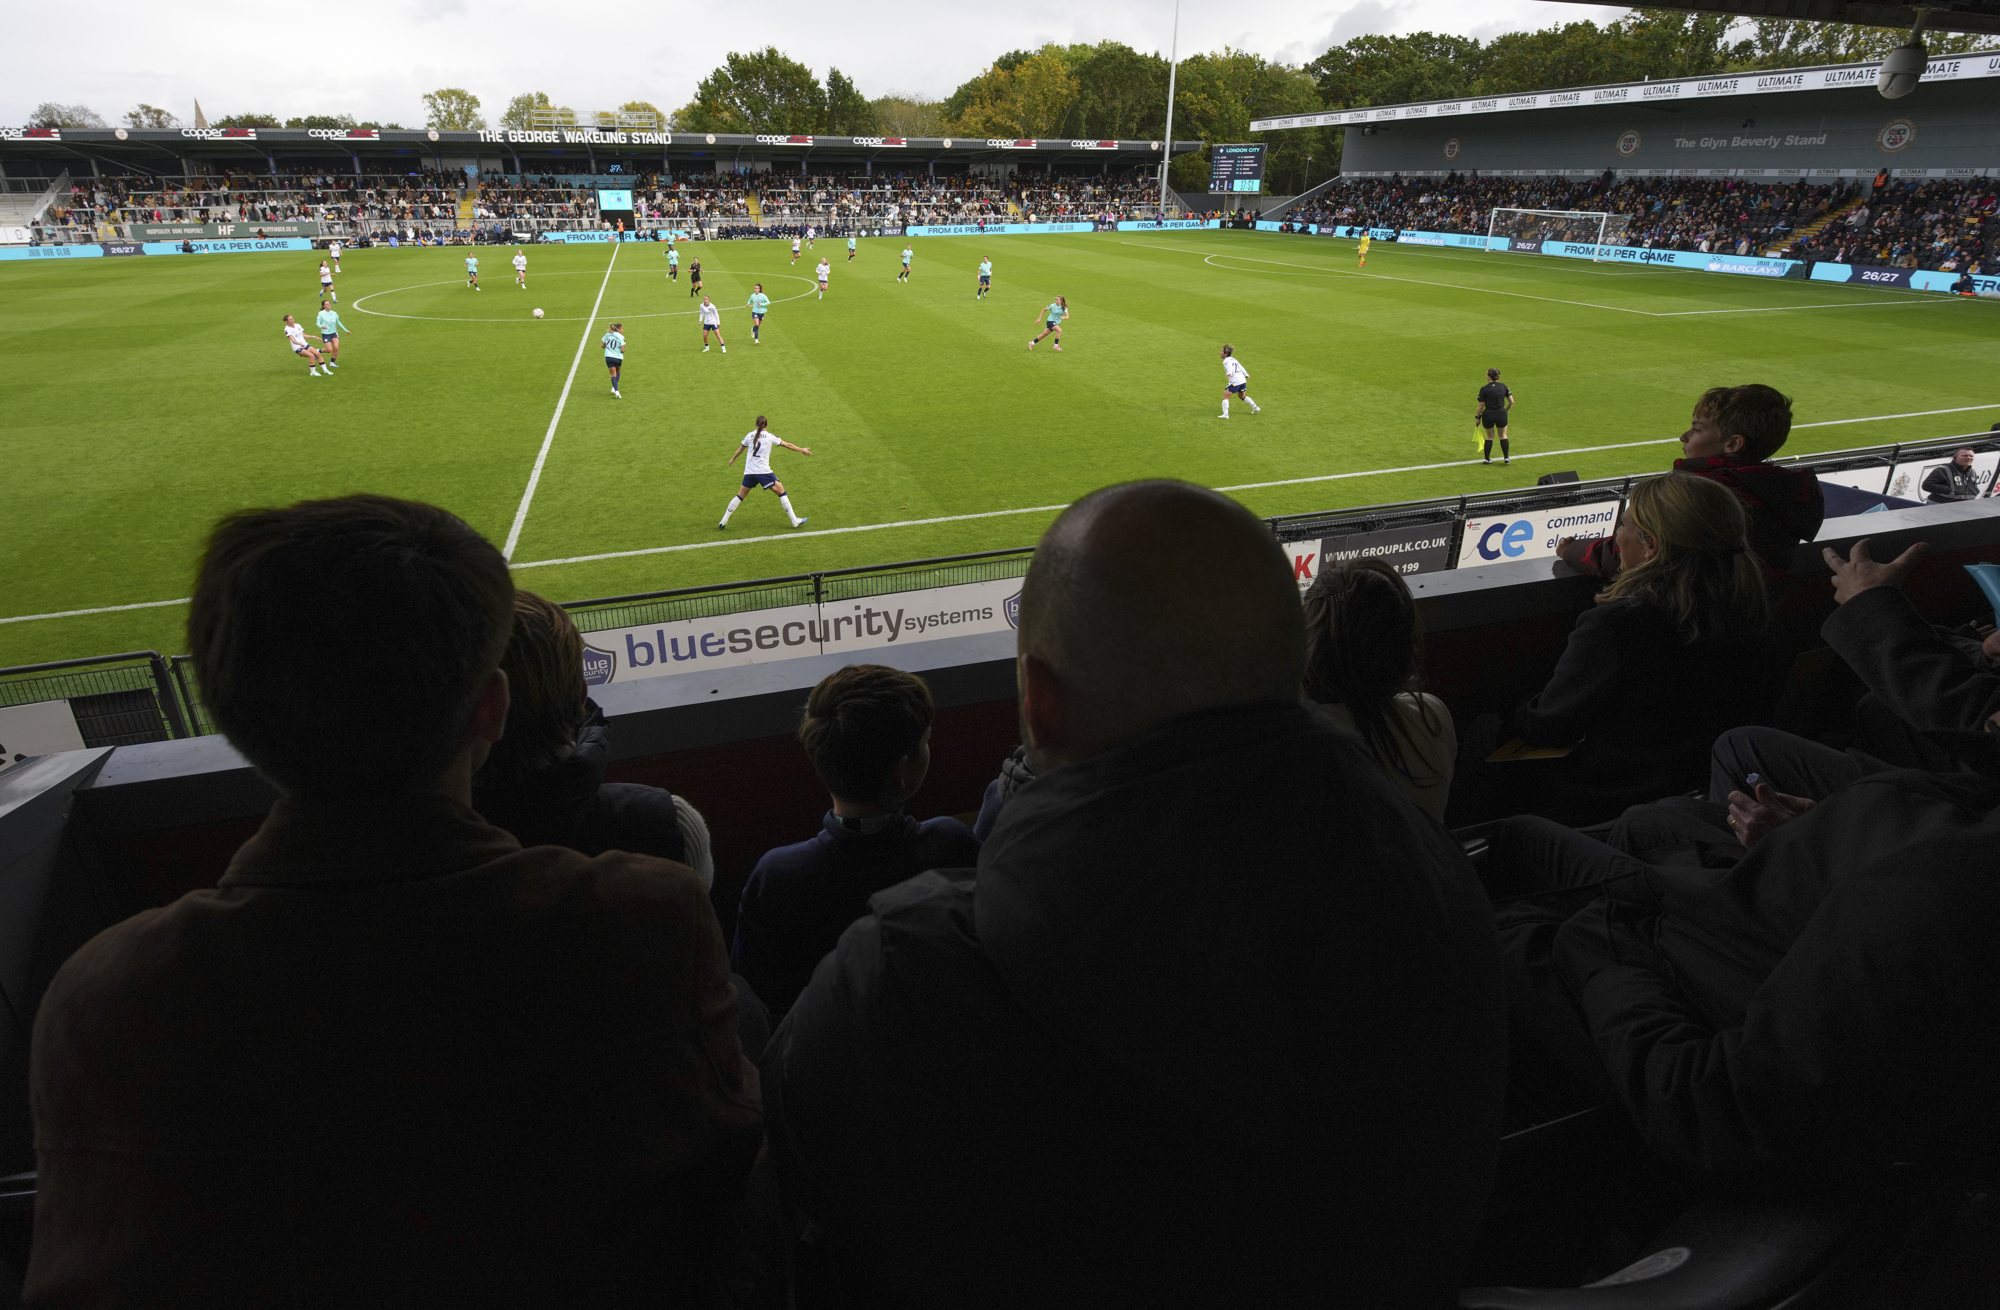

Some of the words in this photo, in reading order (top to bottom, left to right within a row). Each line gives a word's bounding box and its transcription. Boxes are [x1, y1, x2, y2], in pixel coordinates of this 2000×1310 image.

[1758, 75, 1804, 88] ULTIMATE
[1825, 69, 1877, 82] ULTIMATE
[1643, 85, 1680, 95] ULTIMATE
[1697, 80, 1738, 92] ULTIMATE
[1550, 93, 1580, 102] ULTIMATE
[1595, 89, 1628, 99] ULTIMATE
[1472, 100, 1498, 109] ULTIMATE
[1509, 97, 1537, 106] ULTIMATE
[1437, 104, 1461, 112] ULTIMATE
[478, 130, 504, 142] THE
[508, 130, 560, 142] GEORGE
[564, 131, 627, 143] WAKELING
[632, 132, 671, 144] STAND
[1674, 138, 1696, 148] The
[1700, 137, 1727, 150] Glyn
[1731, 136, 1781, 149] Beverly
[1784, 134, 1827, 146] Stand
[218, 225, 235, 235] HF
[1564, 245, 1595, 255] FROM
[1598, 248, 1610, 256] £4
[1614, 250, 1636, 259] PER
[1640, 251, 1676, 262] GAME
[1722, 265, 1779, 274] BARCLAYS
[1862, 271, 1899, 281] 26/27
[753, 440, 761, 457] 2
[1547, 507, 1614, 529] command
[1478, 519, 1534, 560] ce
[1325, 537, 1446, 562] WWW.GROUPLK.CO.UK
[1402, 562, 1419, 573] 199
[583, 659, 608, 671] lue
